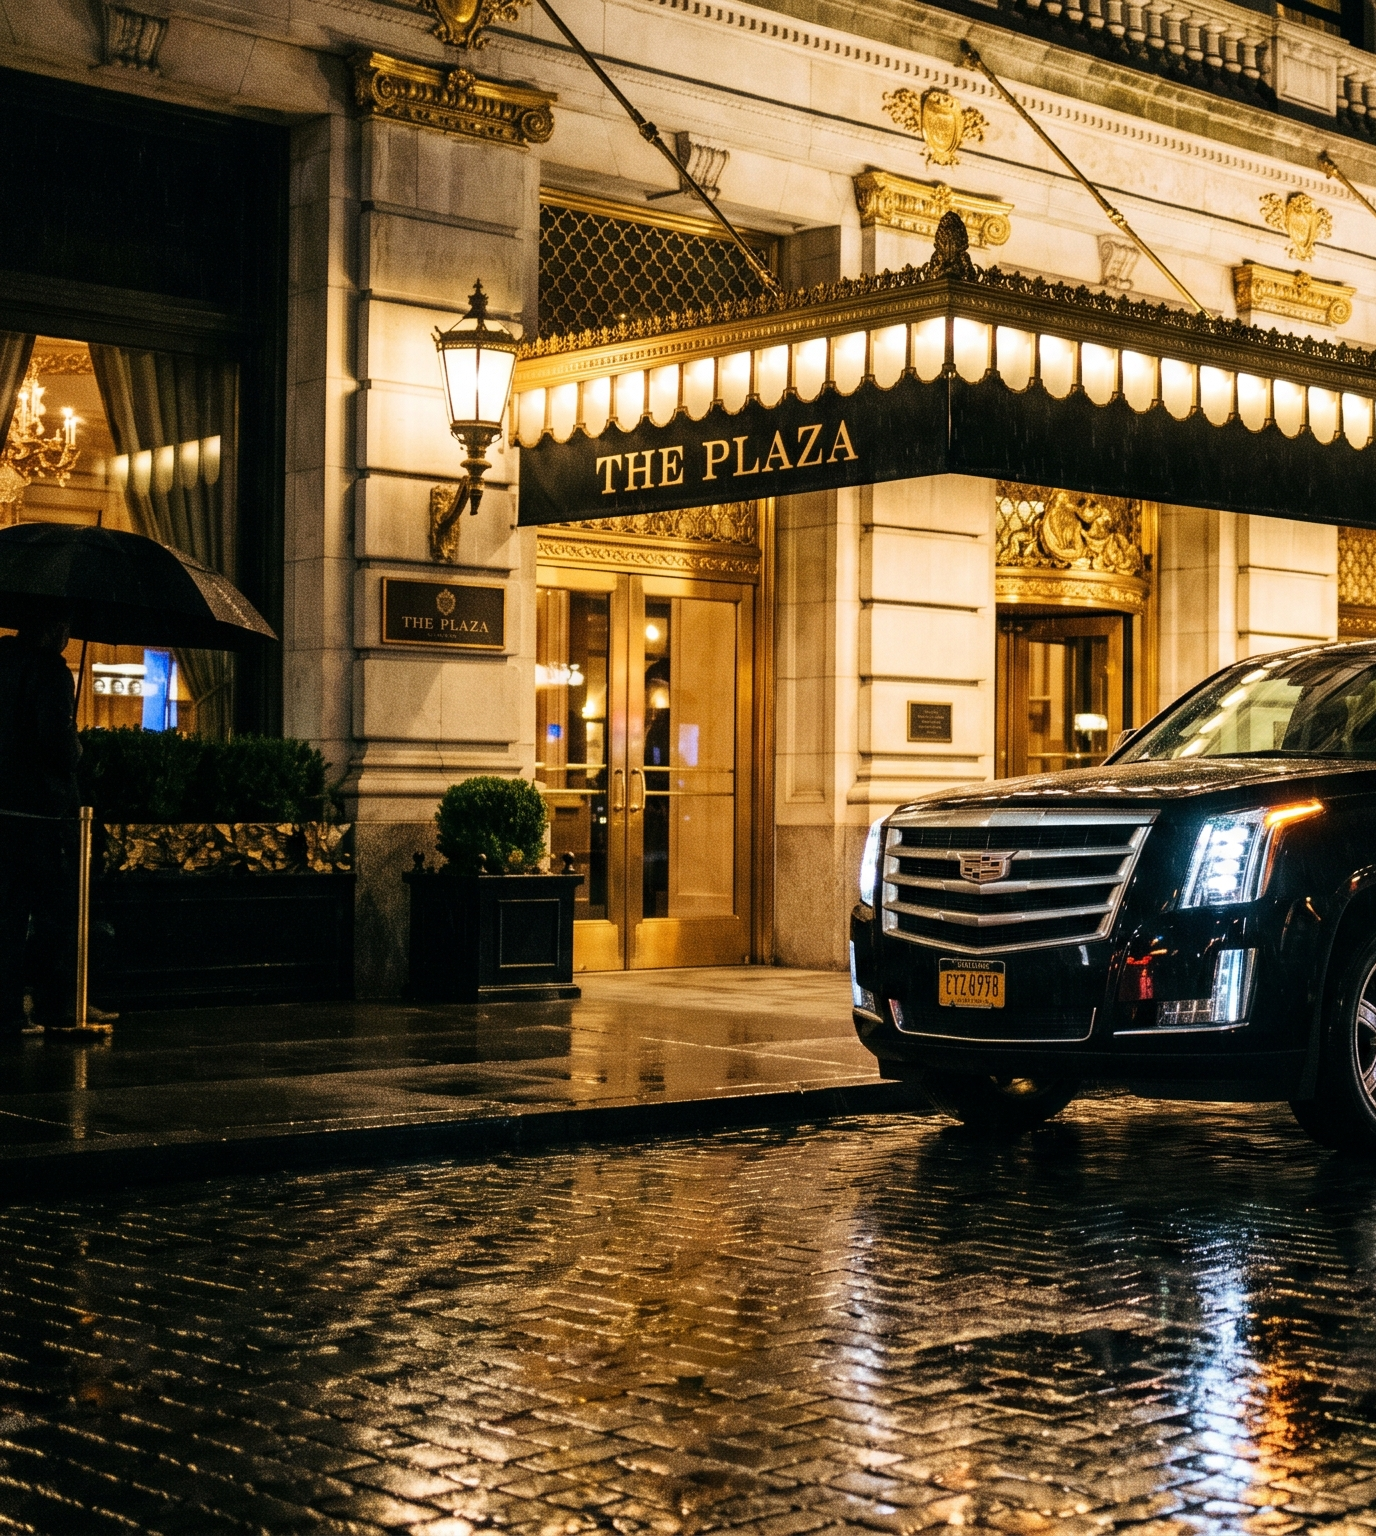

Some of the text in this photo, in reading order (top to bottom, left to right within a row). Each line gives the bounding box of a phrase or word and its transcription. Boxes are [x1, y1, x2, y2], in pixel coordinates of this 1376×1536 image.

[596, 419, 859, 495] THE PLAZA
[402, 616, 490, 633] THE PLAZA
